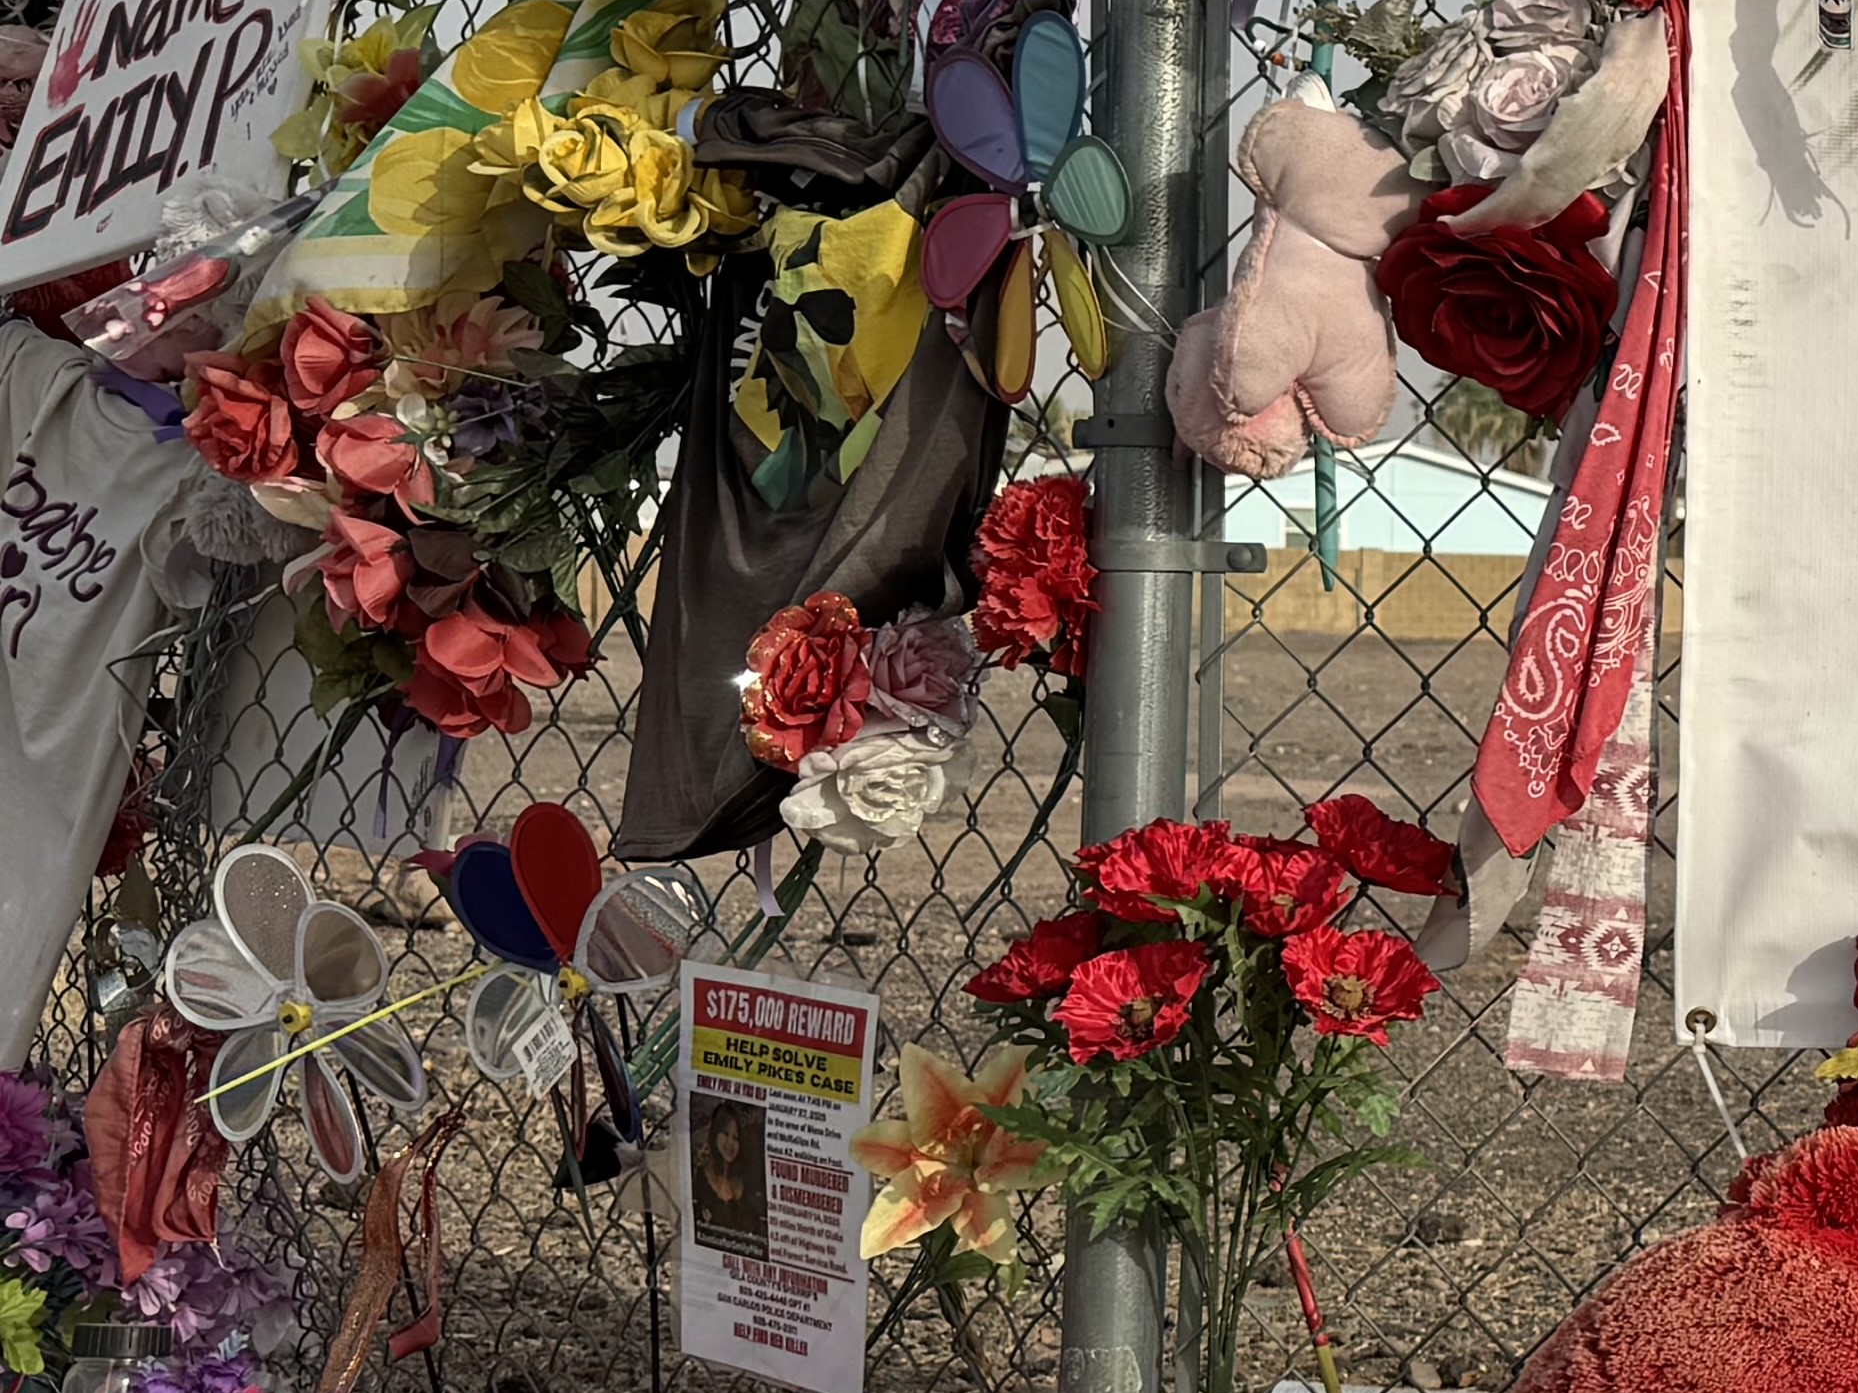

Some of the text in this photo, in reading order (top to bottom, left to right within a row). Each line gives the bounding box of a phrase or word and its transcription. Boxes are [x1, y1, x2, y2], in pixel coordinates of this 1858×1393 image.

[706, 989, 855, 1045] $175,000 REWARD
[703, 1051, 753, 1073] EMILY
[811, 1074, 854, 1094] CASE
[726, 1037, 827, 1071] HELP SOLVE
